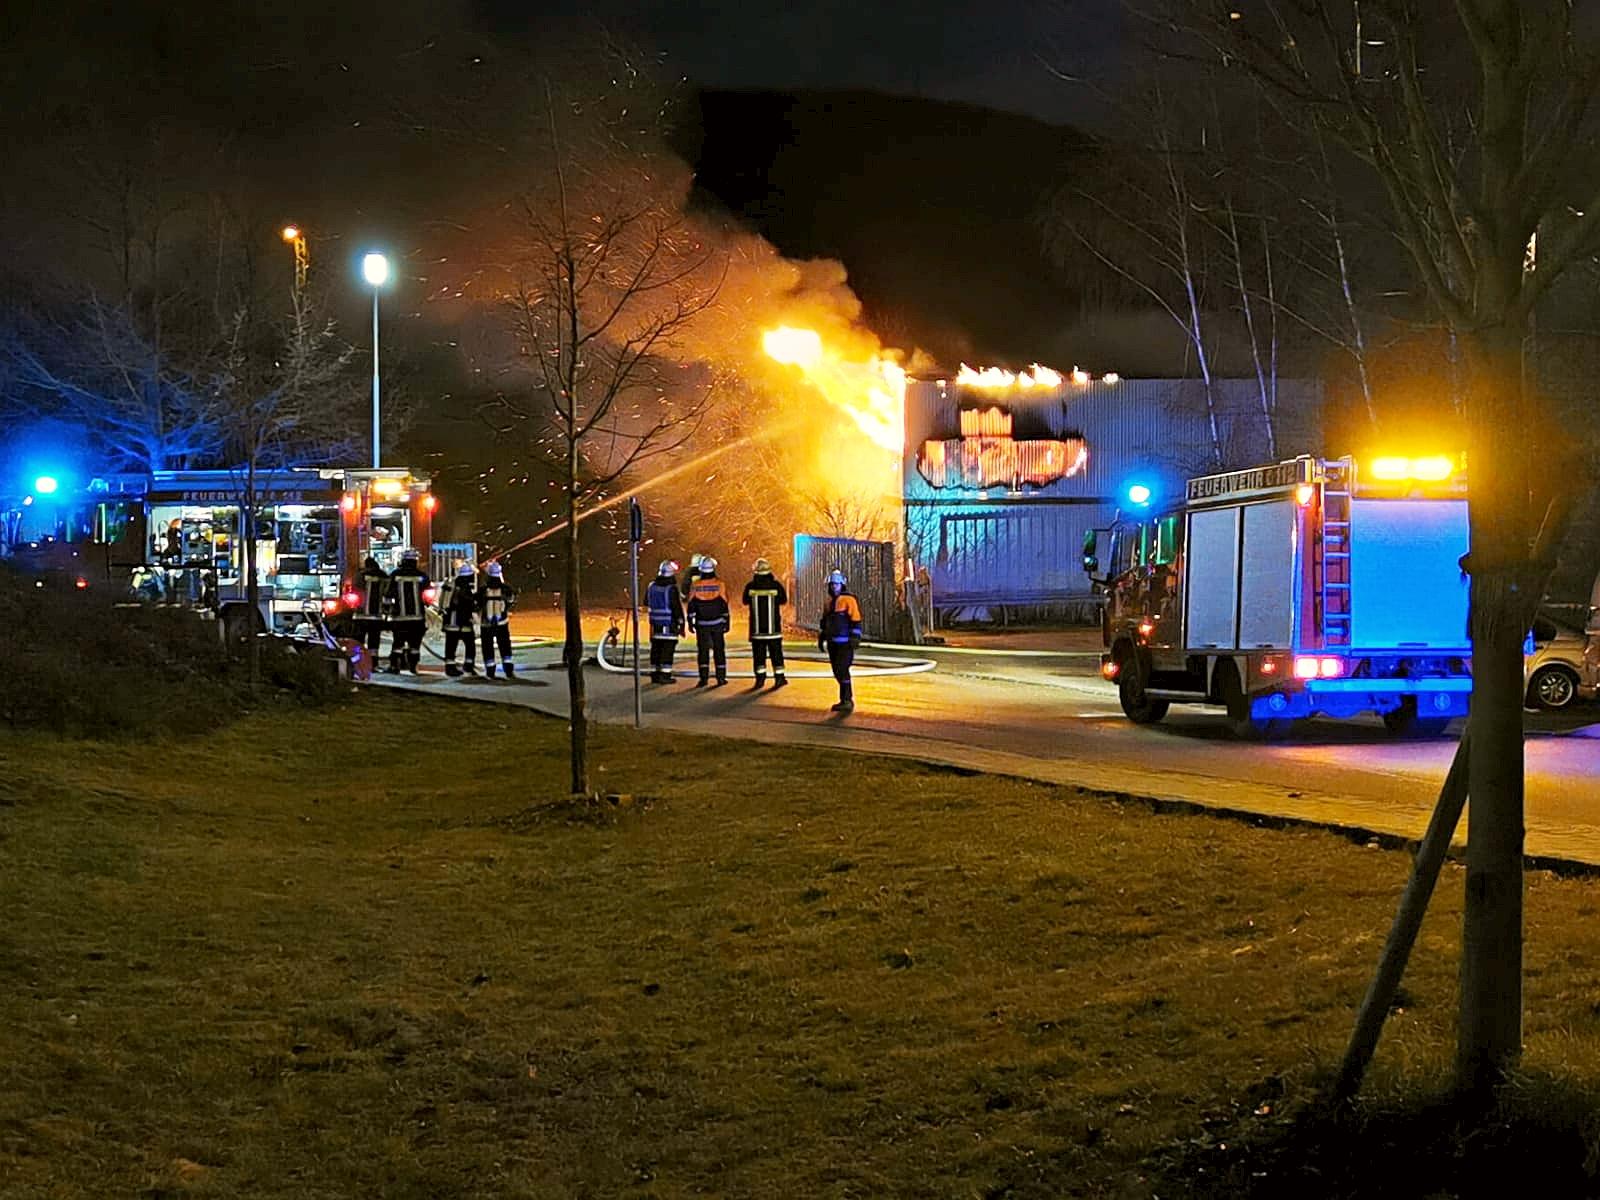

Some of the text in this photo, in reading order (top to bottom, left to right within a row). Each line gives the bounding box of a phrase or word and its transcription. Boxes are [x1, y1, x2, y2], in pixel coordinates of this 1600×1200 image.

[1191, 464, 1296, 498] FEUERWEHR 112
[183, 490, 263, 501] FEUERWER
